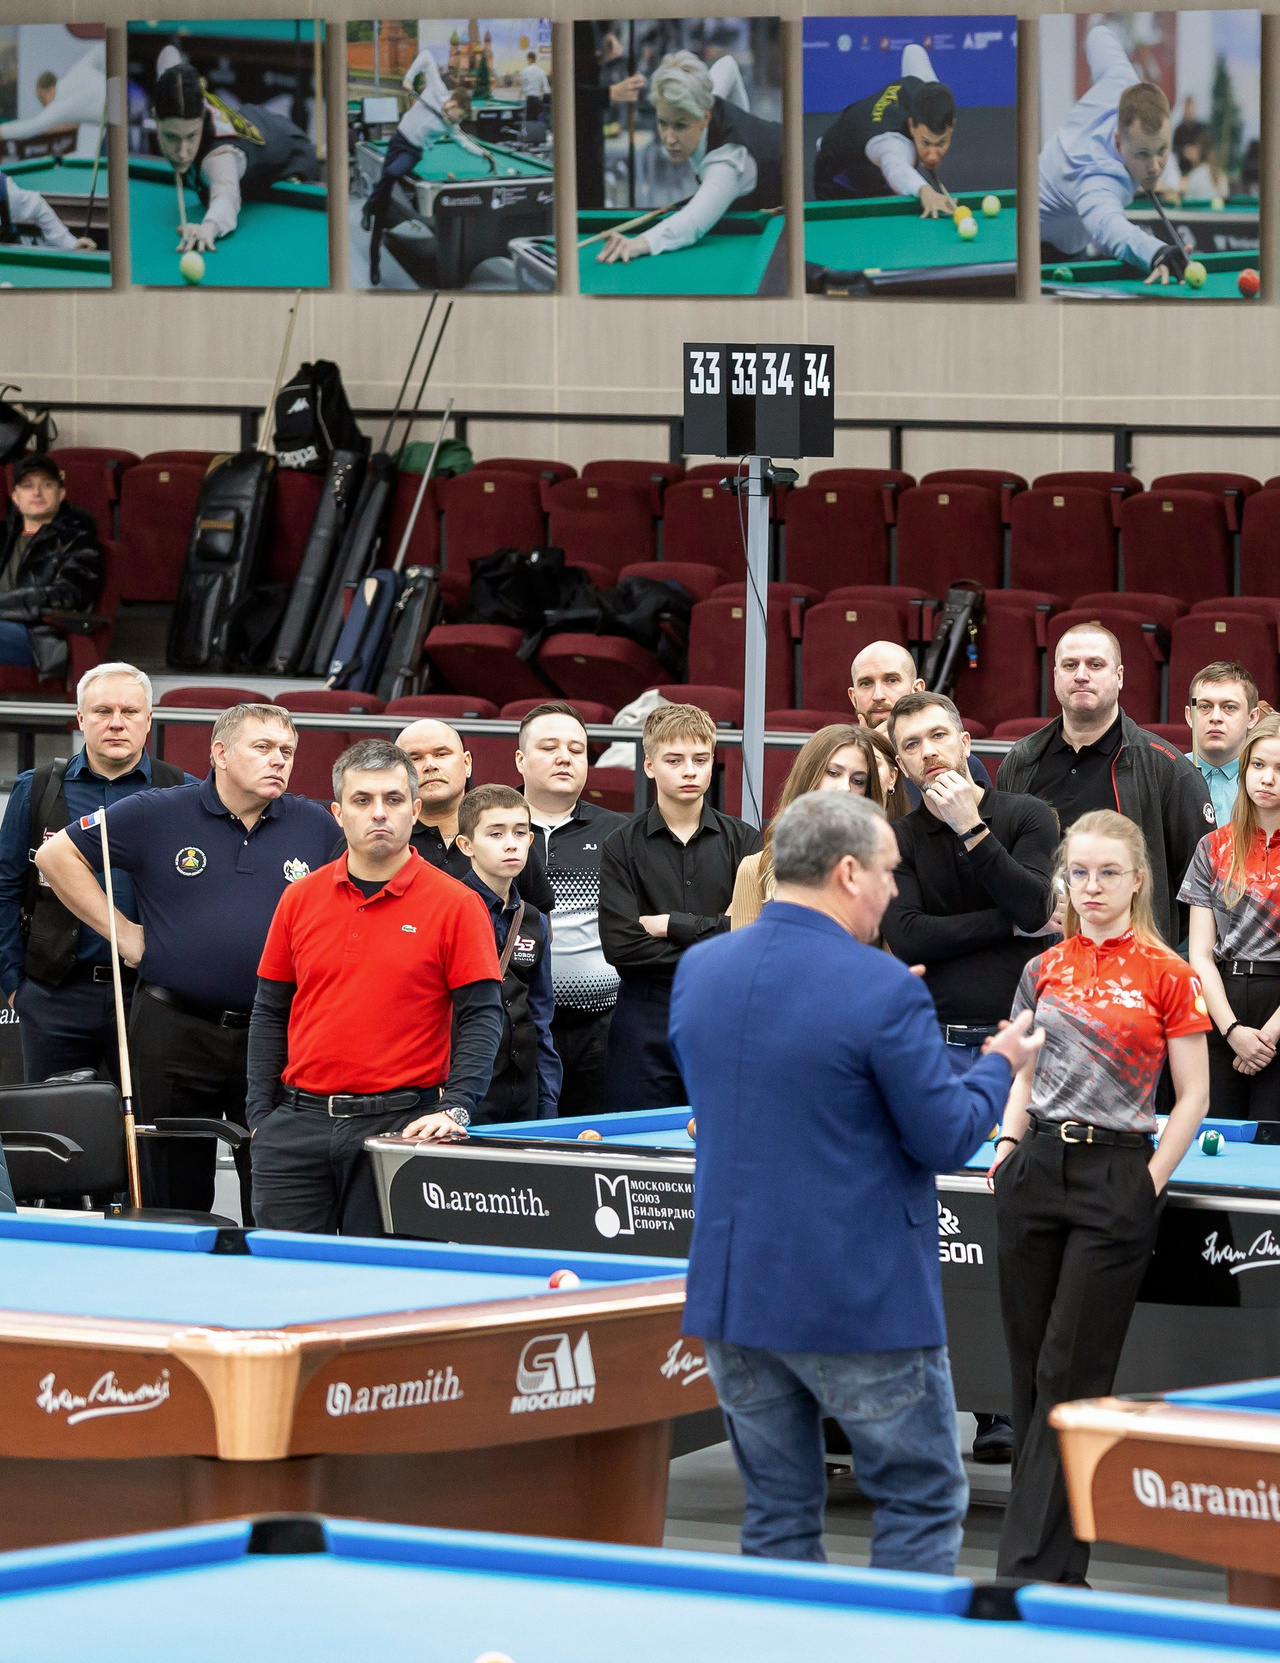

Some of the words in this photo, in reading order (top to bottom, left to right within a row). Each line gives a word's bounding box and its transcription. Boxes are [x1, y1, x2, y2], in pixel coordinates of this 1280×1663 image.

[690, 351, 720, 394] 33
[732, 352, 756, 395] 33
[762, 352, 794, 396] 34
[804, 353, 830, 396] 34
[450, 1187, 545, 1217] aramith
[631, 1193, 661, 1204] СОЮЗ
[633, 1206, 695, 1220] БИЛЬЯРДНО
[634, 1219, 675, 1231] СПОРТА
[354, 1366, 460, 1414] aramith
[510, 1387, 596, 1415] МОСКВИЧ
